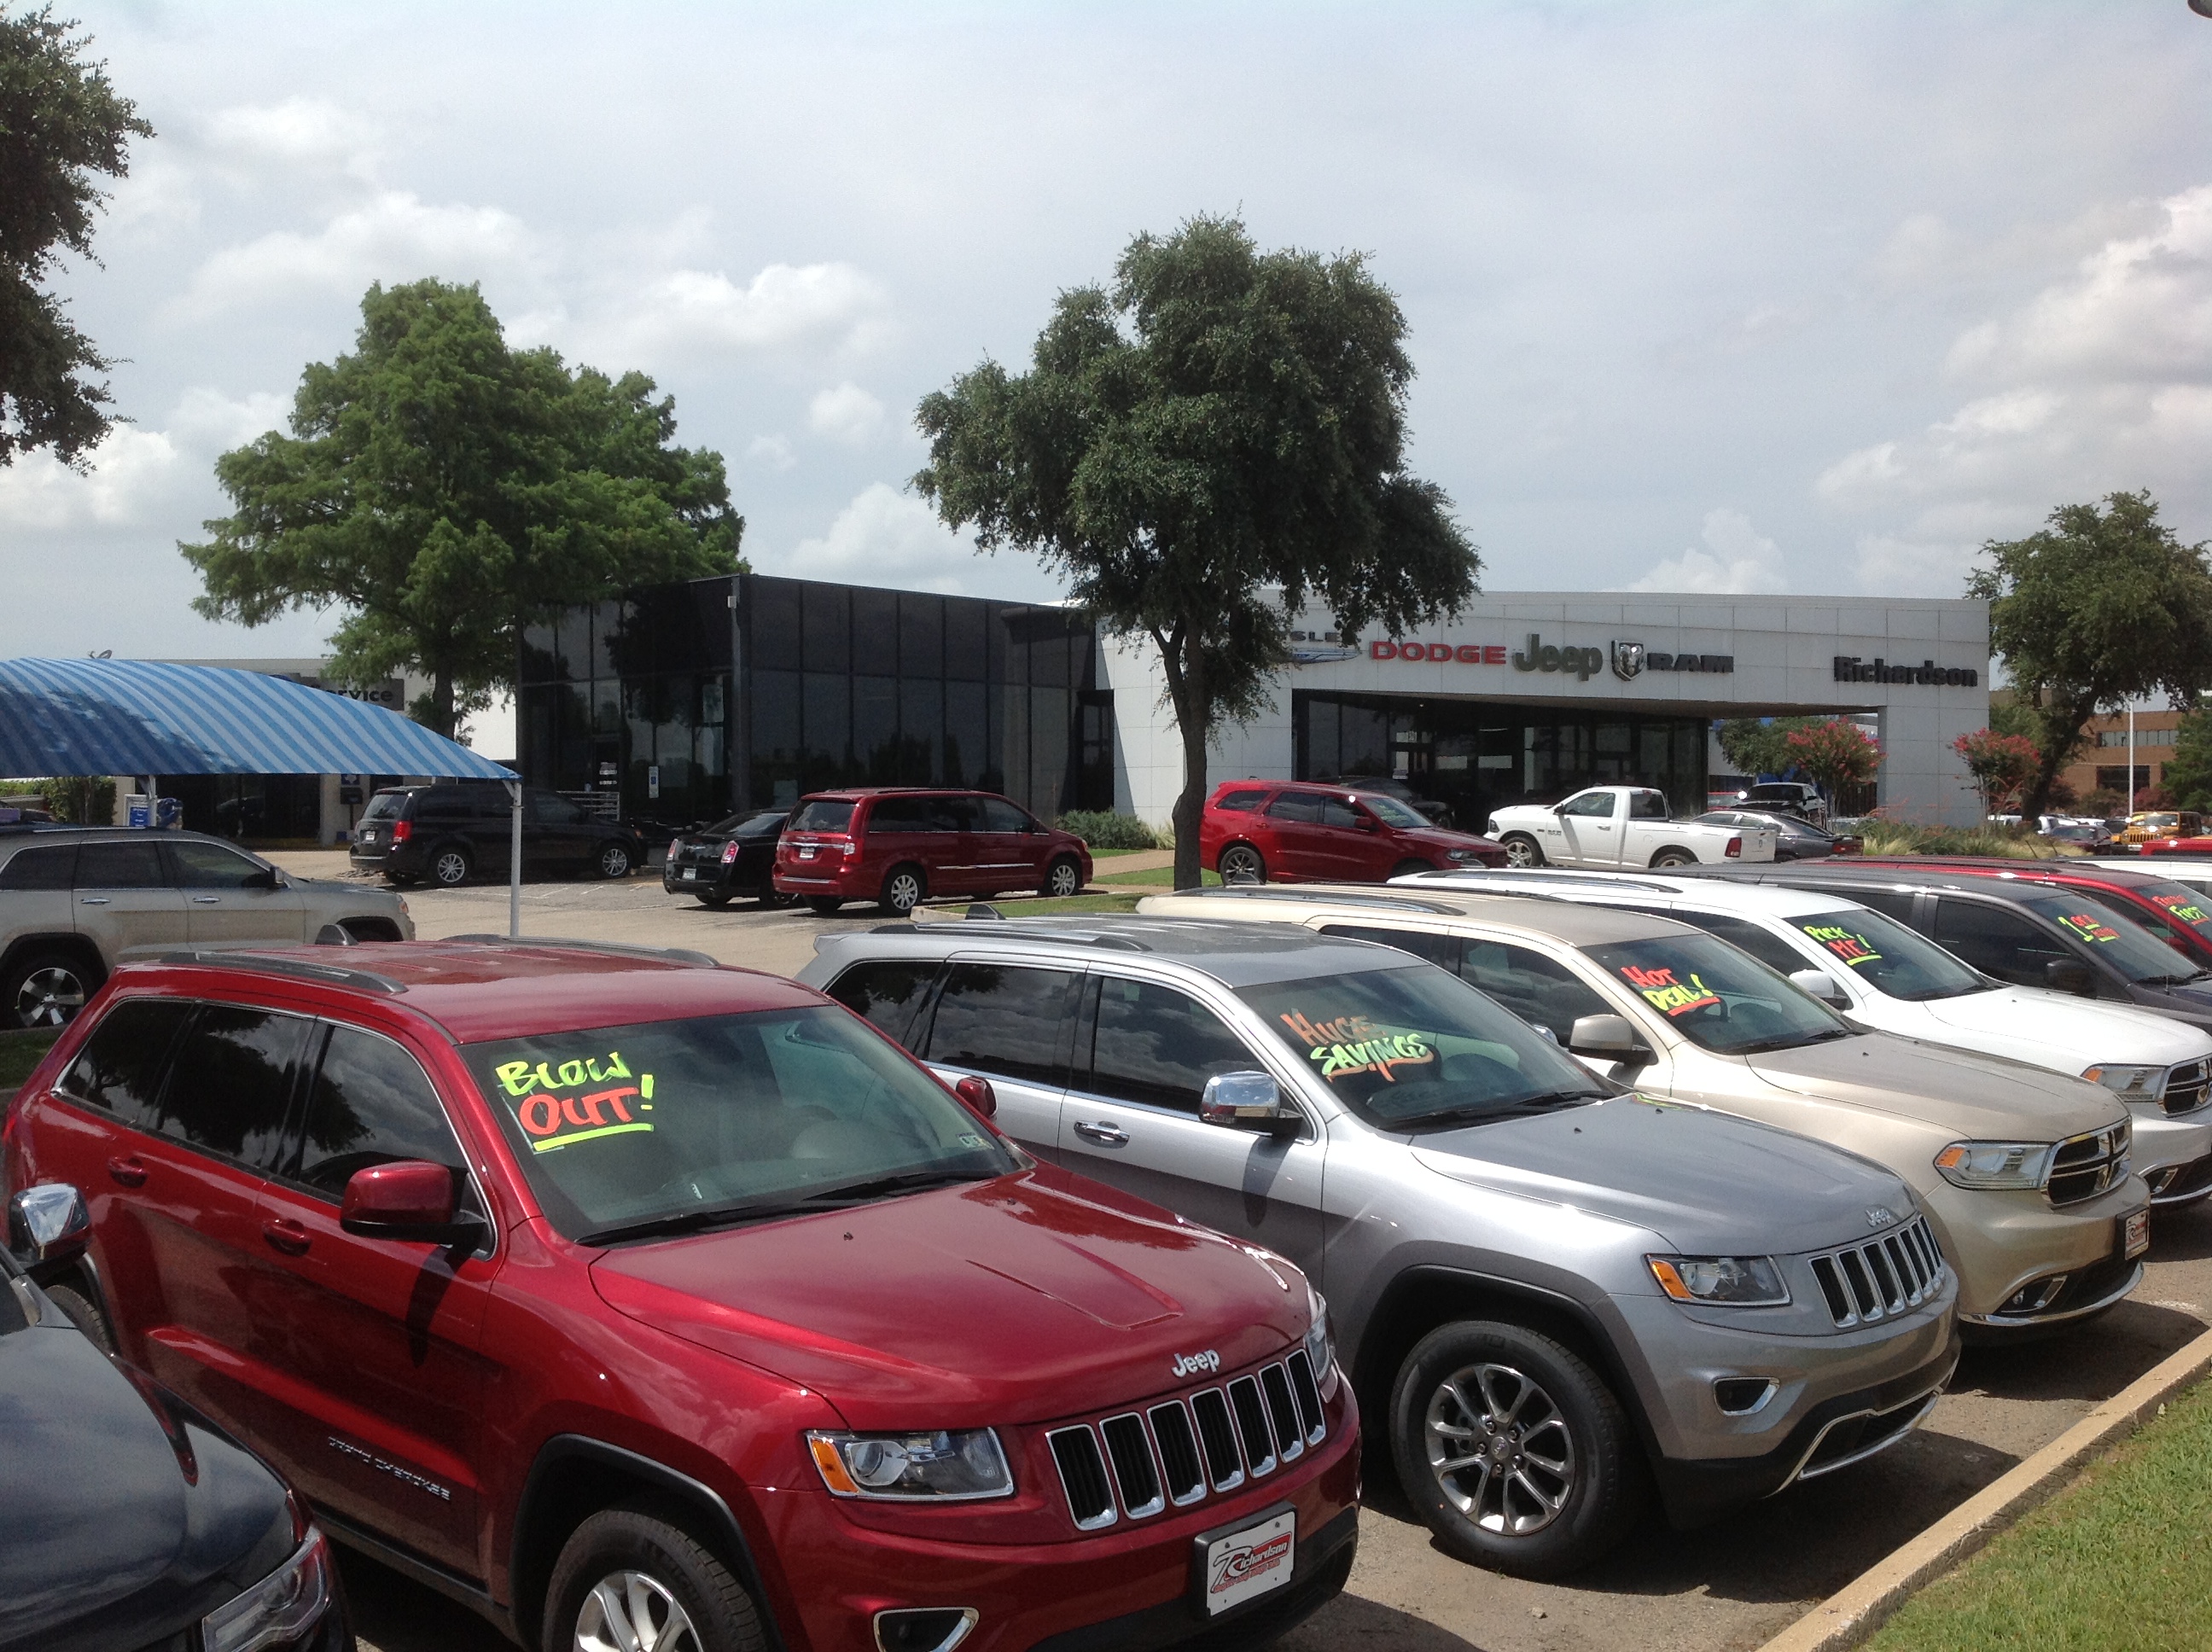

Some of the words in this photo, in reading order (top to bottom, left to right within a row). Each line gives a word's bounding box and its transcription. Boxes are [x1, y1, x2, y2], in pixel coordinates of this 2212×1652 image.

[1370, 641, 1506, 665] DODGE
[1513, 633, 1604, 682] Jeep
[1647, 653, 1734, 672] RAM
[1834, 656, 1978, 686] Richardson
[323, 687, 393, 701] rvice
[1621, 966, 1679, 988] HOT
[1310, 1033, 1429, 1076] SAVINGS
[495, 1051, 633, 1096] BLOW
[1866, 1208, 1891, 1226] Jeep
[1172, 1349, 1220, 1377] Jeep
[1210, 1542, 1289, 1594] Richardson
